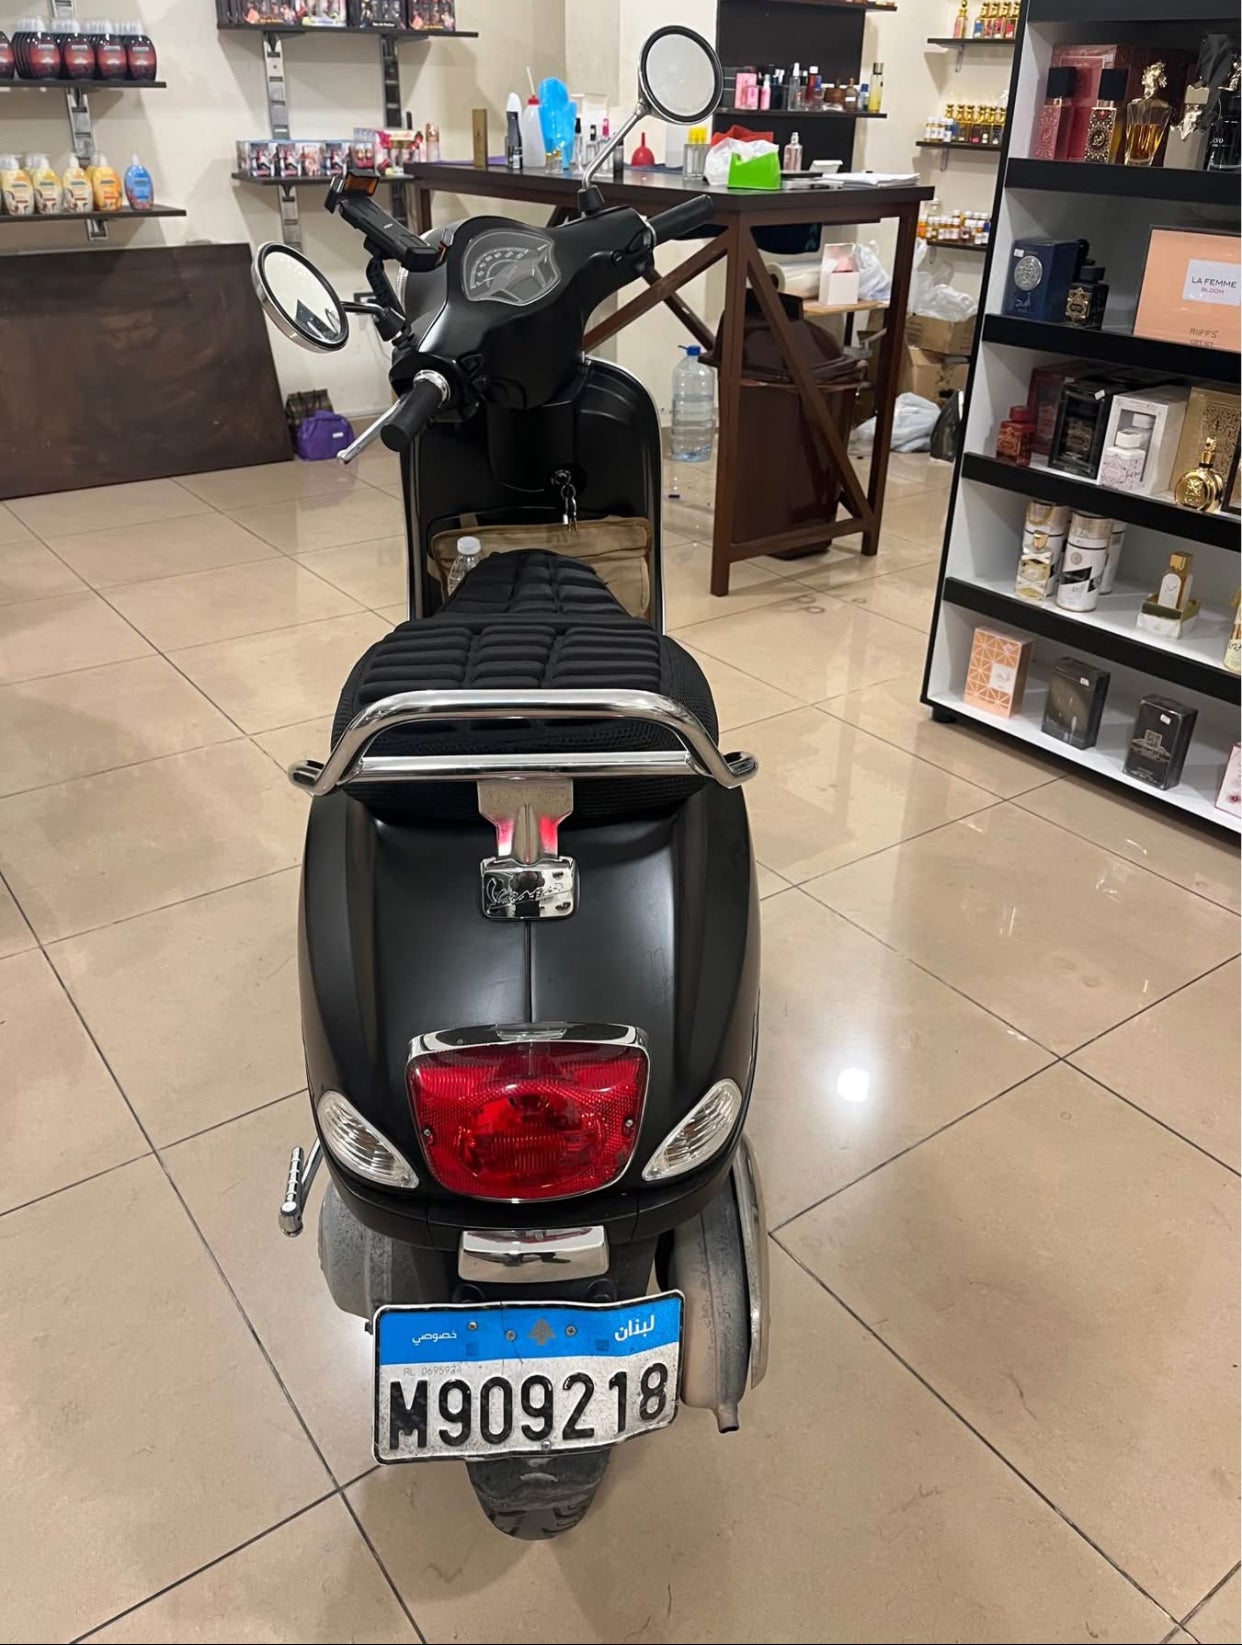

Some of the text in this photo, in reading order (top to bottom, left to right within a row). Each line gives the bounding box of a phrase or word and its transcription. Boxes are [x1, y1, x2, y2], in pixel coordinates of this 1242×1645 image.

[1204, 278, 1237, 288] FEMME
[411, 1330, 457, 1344] خصوصي
[614, 1314, 656, 1341] لبنان
[389, 1362, 669, 1449] M909218
